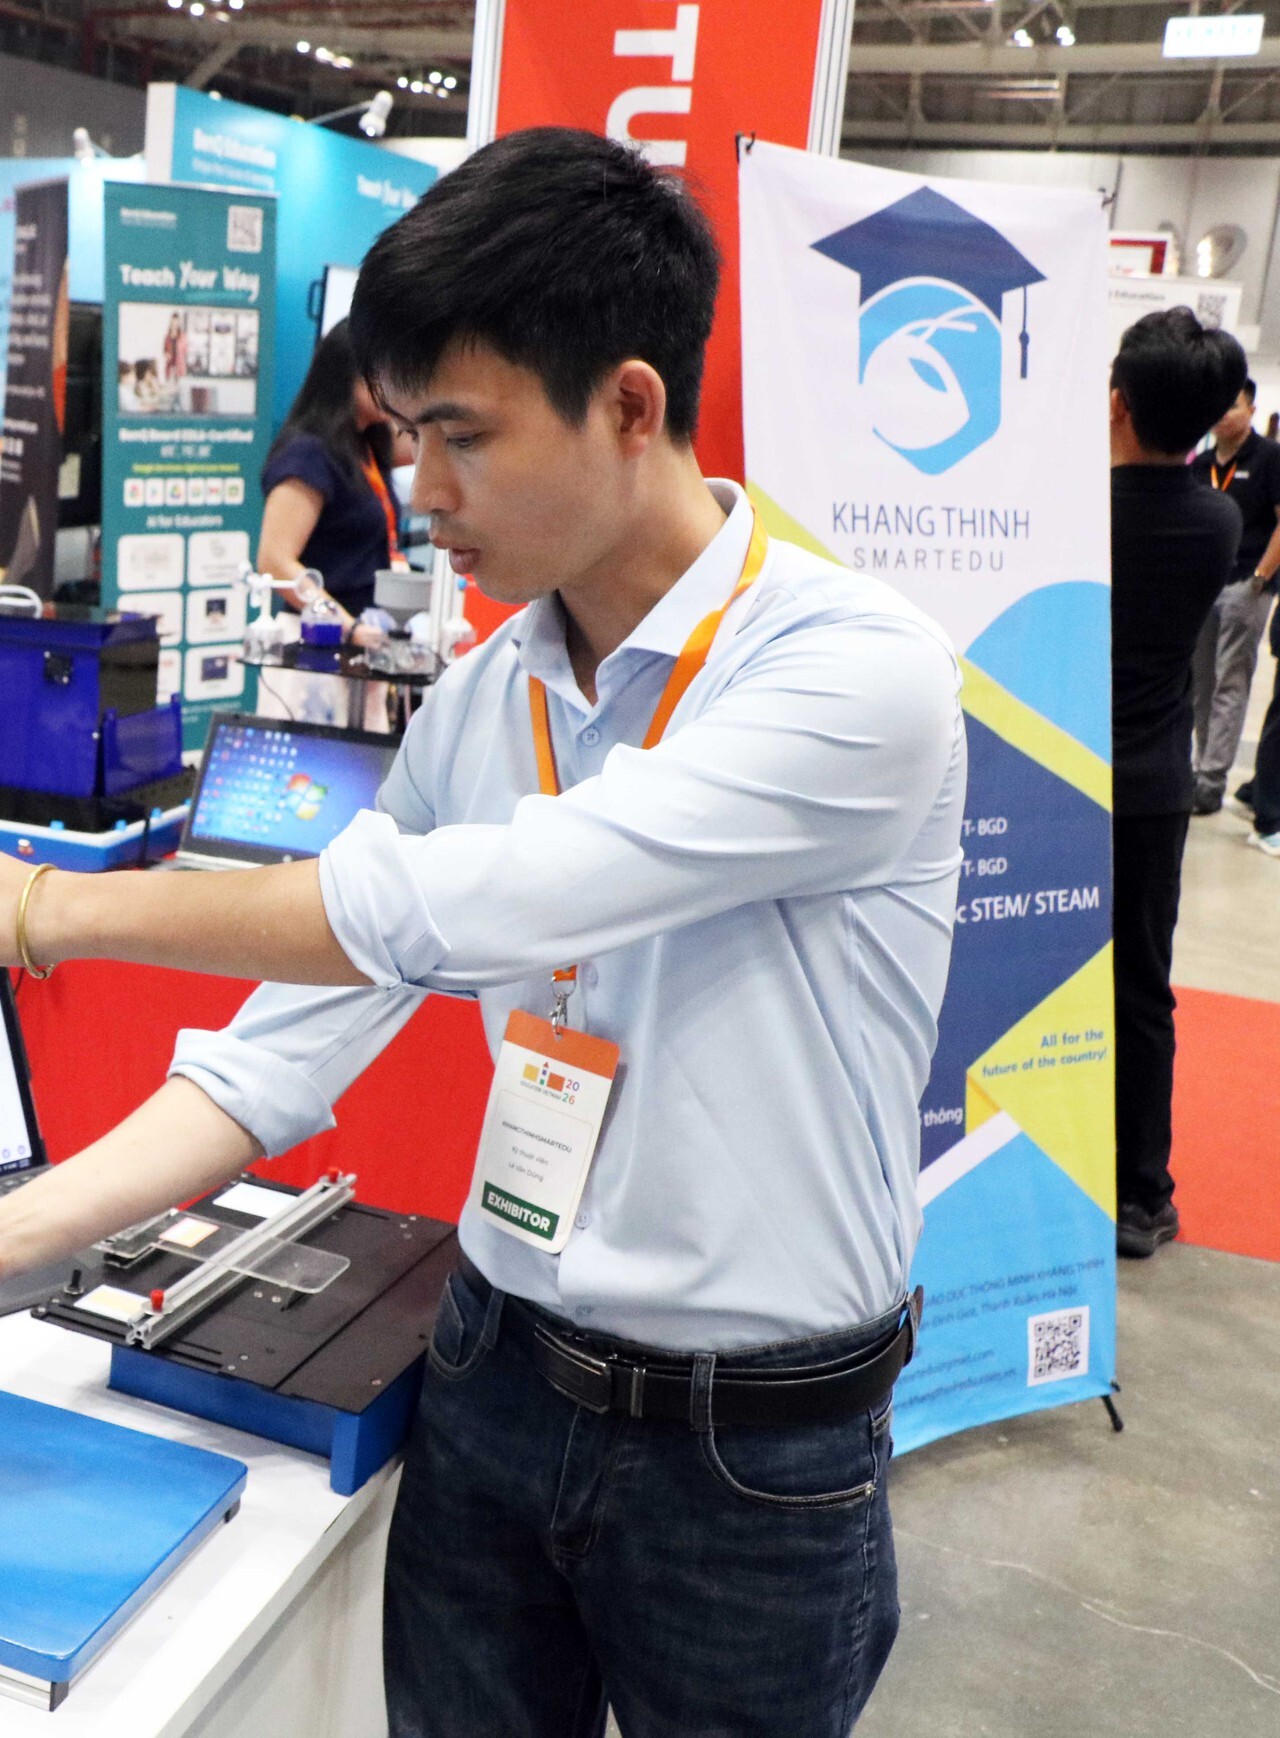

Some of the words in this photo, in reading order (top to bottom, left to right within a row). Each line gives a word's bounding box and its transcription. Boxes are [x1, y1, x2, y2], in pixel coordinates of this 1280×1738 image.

[606, 4, 699, 167] TU
[120, 263, 175, 288] Teach
[179, 260, 218, 290] Your
[222, 265, 260, 304] Way
[853, 546, 1004, 572] SMARTEDU
[955, 904, 967, 923] c
[970, 892, 1031, 922] STEM/
[1035, 886, 1100, 915] STEAM
[1041, 1033, 1057, 1048] All
[1062, 1031, 1080, 1045] for
[1085, 1028, 1104, 1042] the
[982, 1063, 1018, 1078] future
[1022, 1058, 1034, 1071] of
[1038, 1055, 1056, 1069] the
[1060, 1047, 1108, 1065] country!
[561, 1092, 576, 1105] 26
[565, 1078, 580, 1092] 20
[487, 1191, 551, 1233] EXHIBITOR
